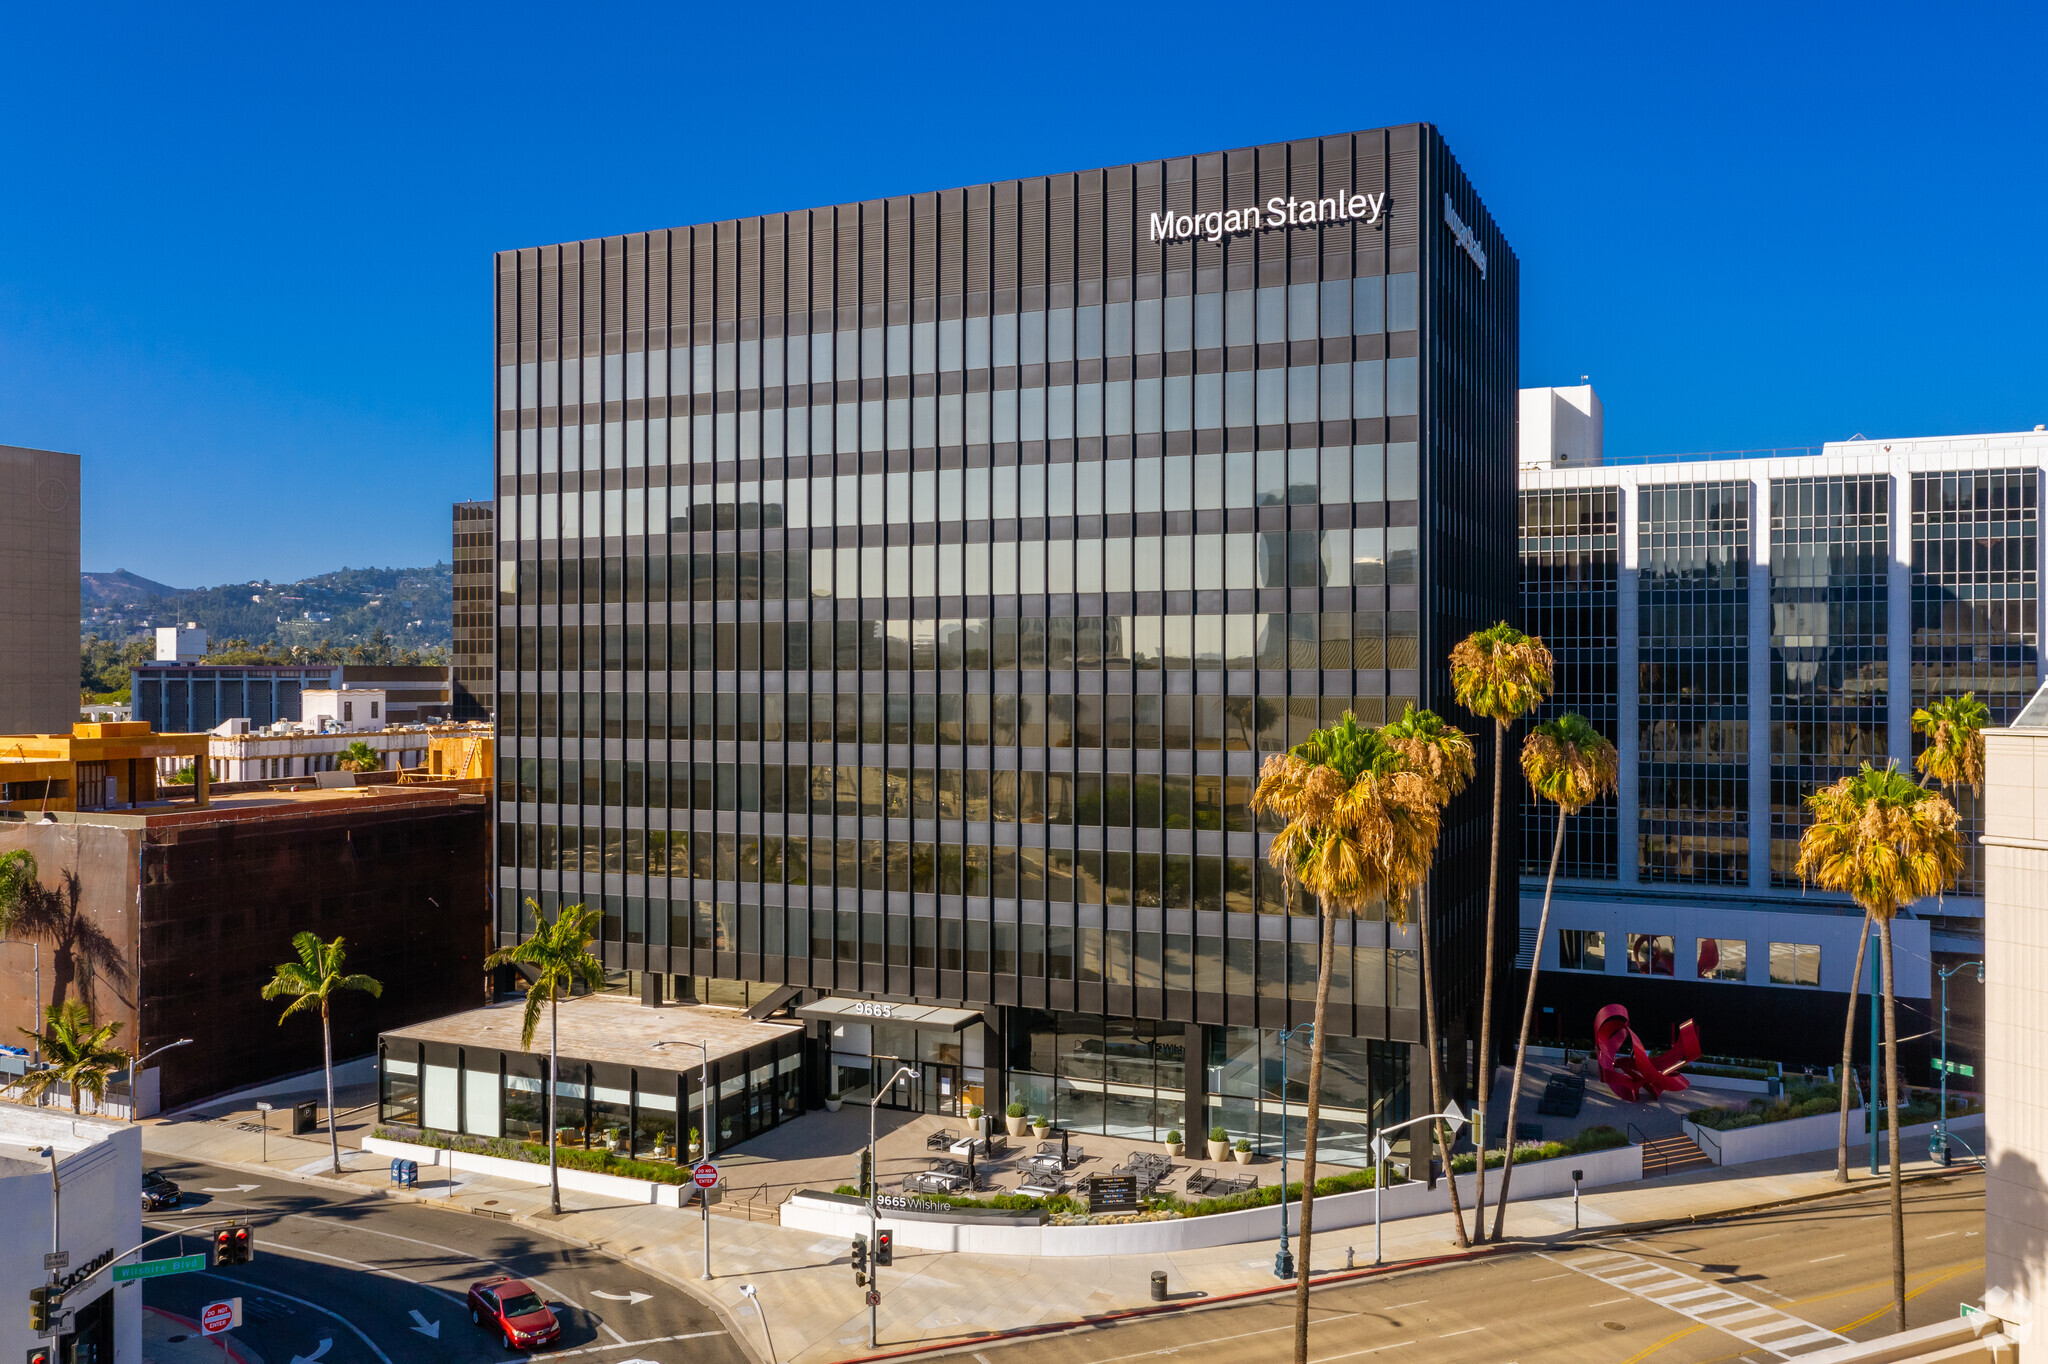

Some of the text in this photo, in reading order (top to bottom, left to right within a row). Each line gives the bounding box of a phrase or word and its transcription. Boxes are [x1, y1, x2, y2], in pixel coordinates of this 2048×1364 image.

[1150, 189, 1386, 242] Morgan Stanley
[855, 1002, 891, 1018] 9665
[877, 1195, 951, 1211] 9665 Wilshire
[122, 1259, 197, 1277] Wilshire Blvd
[217, 1306, 228, 1315] NOT
[209, 1319, 227, 1329] ENTER
